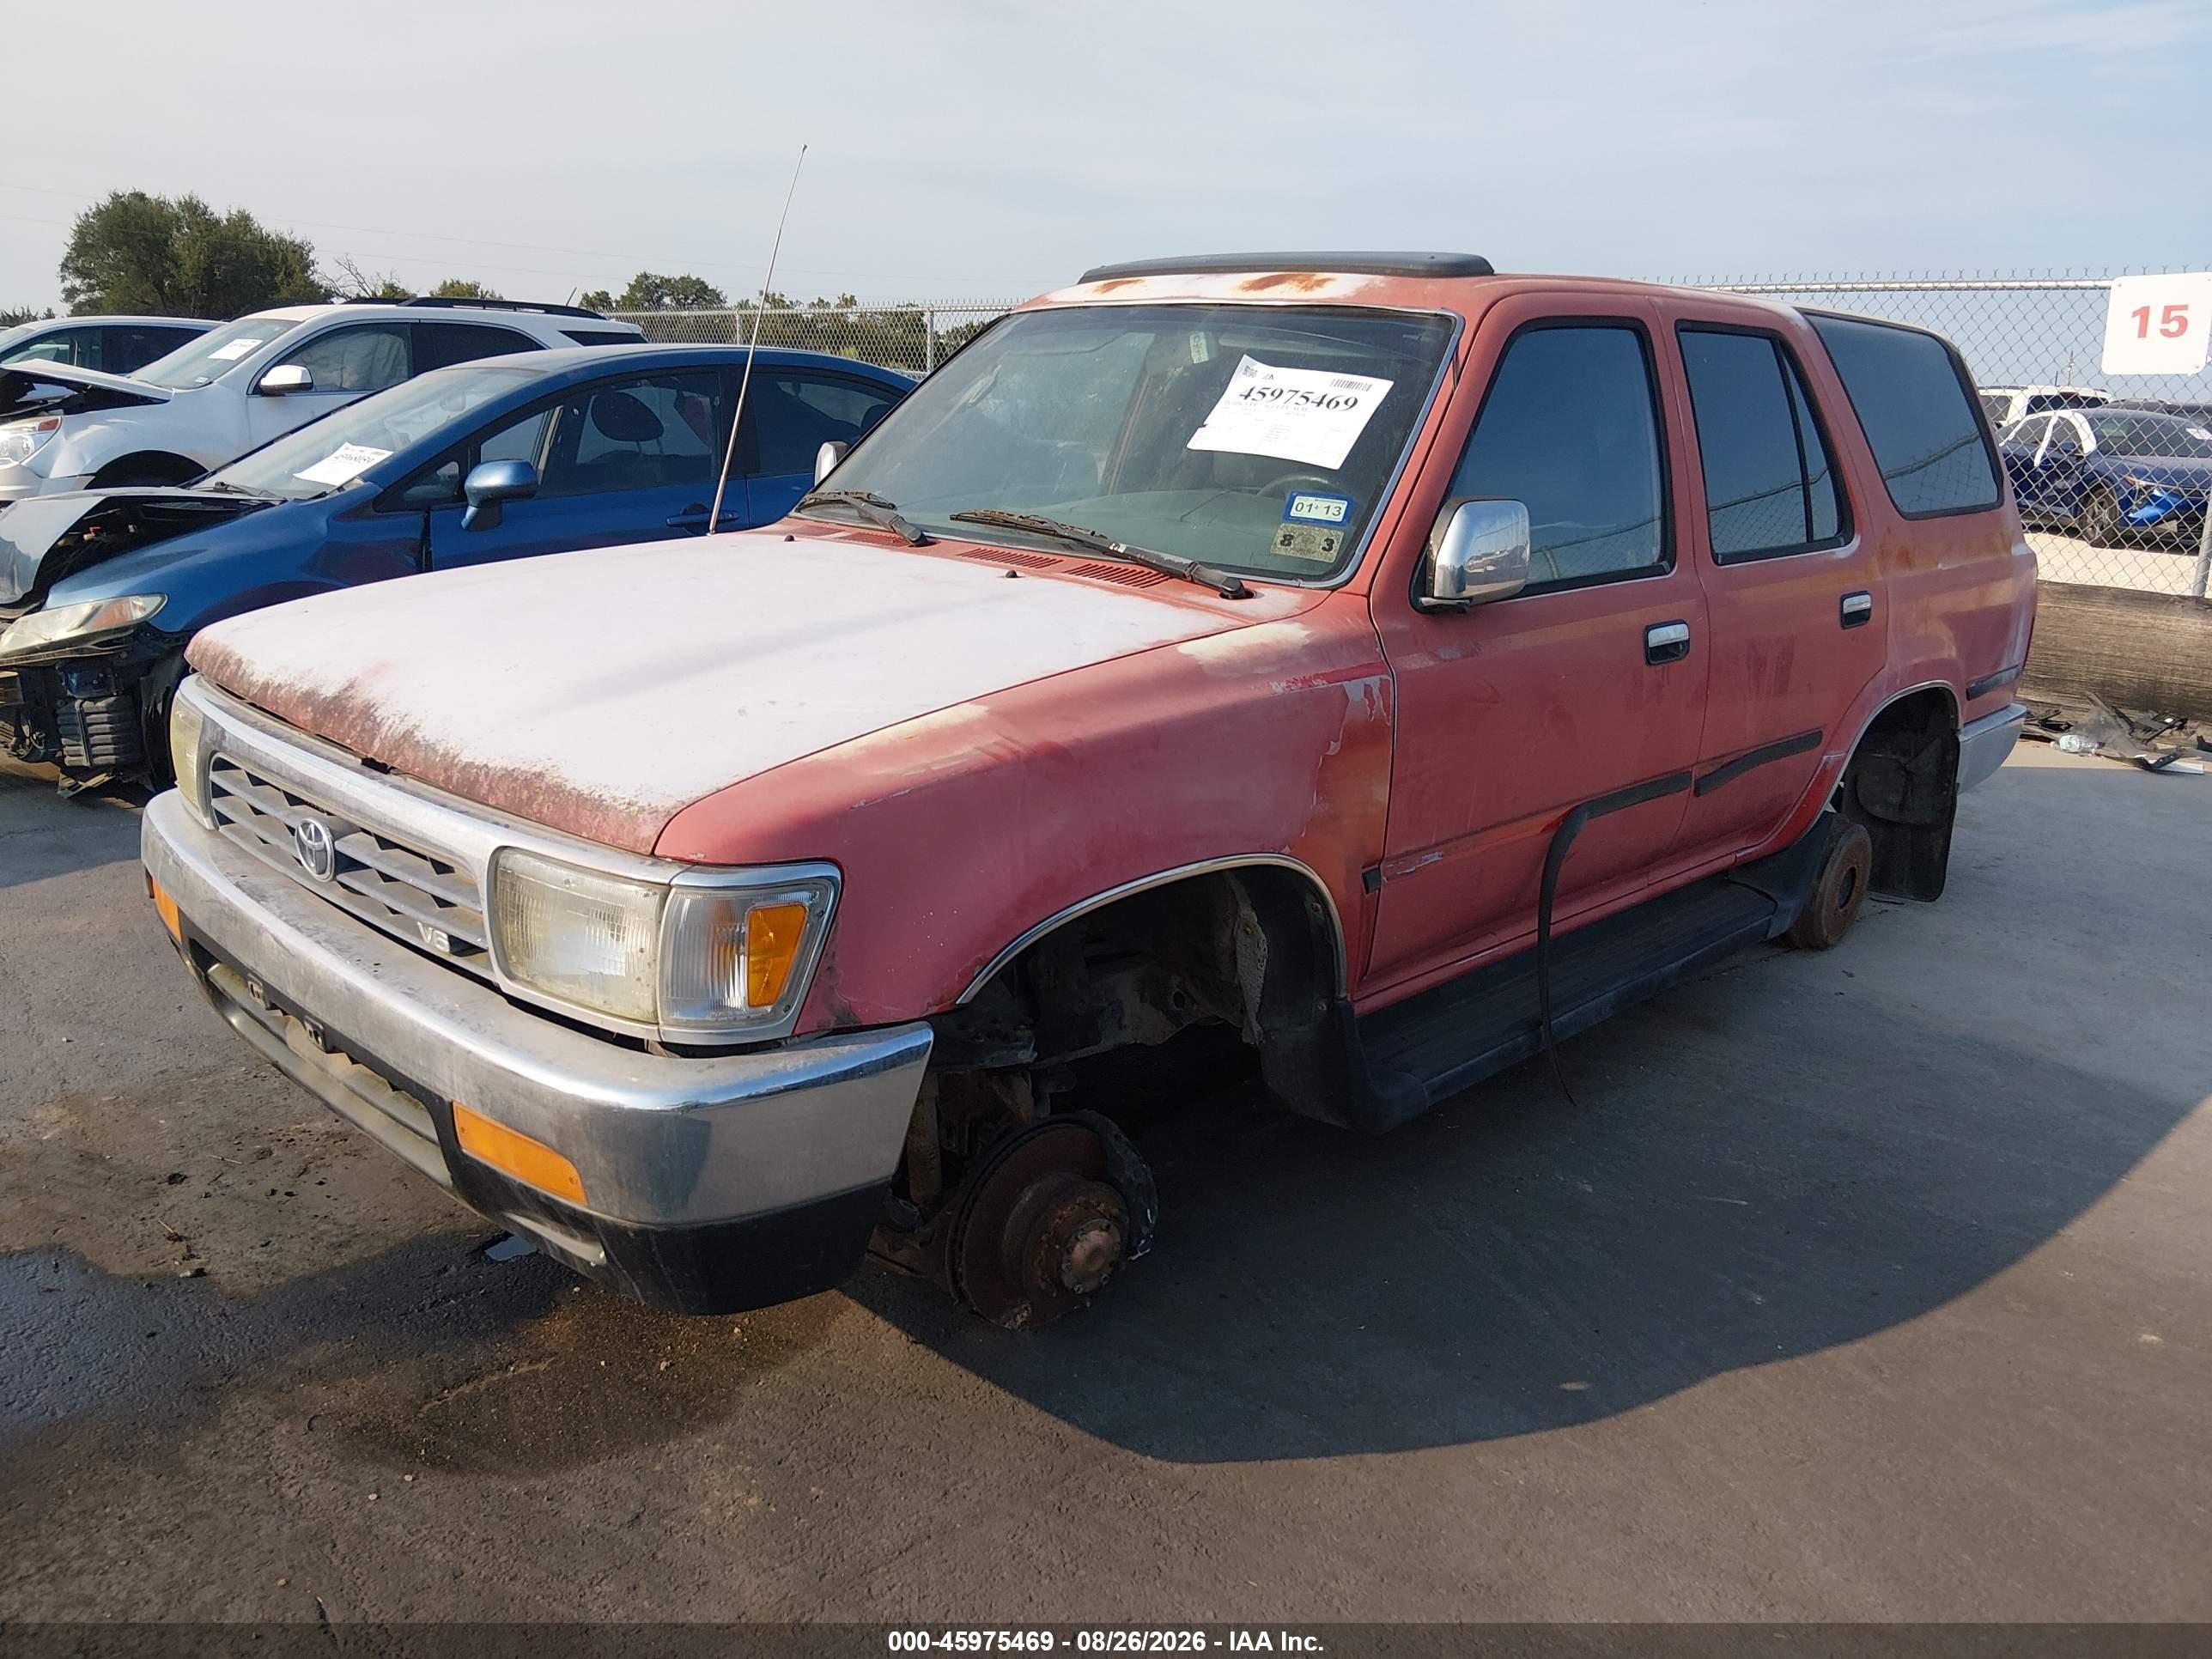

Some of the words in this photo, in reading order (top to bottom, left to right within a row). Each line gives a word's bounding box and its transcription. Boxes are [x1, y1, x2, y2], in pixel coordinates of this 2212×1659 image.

[2131, 304, 2189, 338] 15
[1239, 386, 1358, 412] 45975469
[1295, 501, 1314, 514] 01
[1323, 505, 1342, 517] 13
[1280, 533, 1294, 547] 8
[1321, 538, 1334, 552] 3
[416, 921, 451, 953] V6
